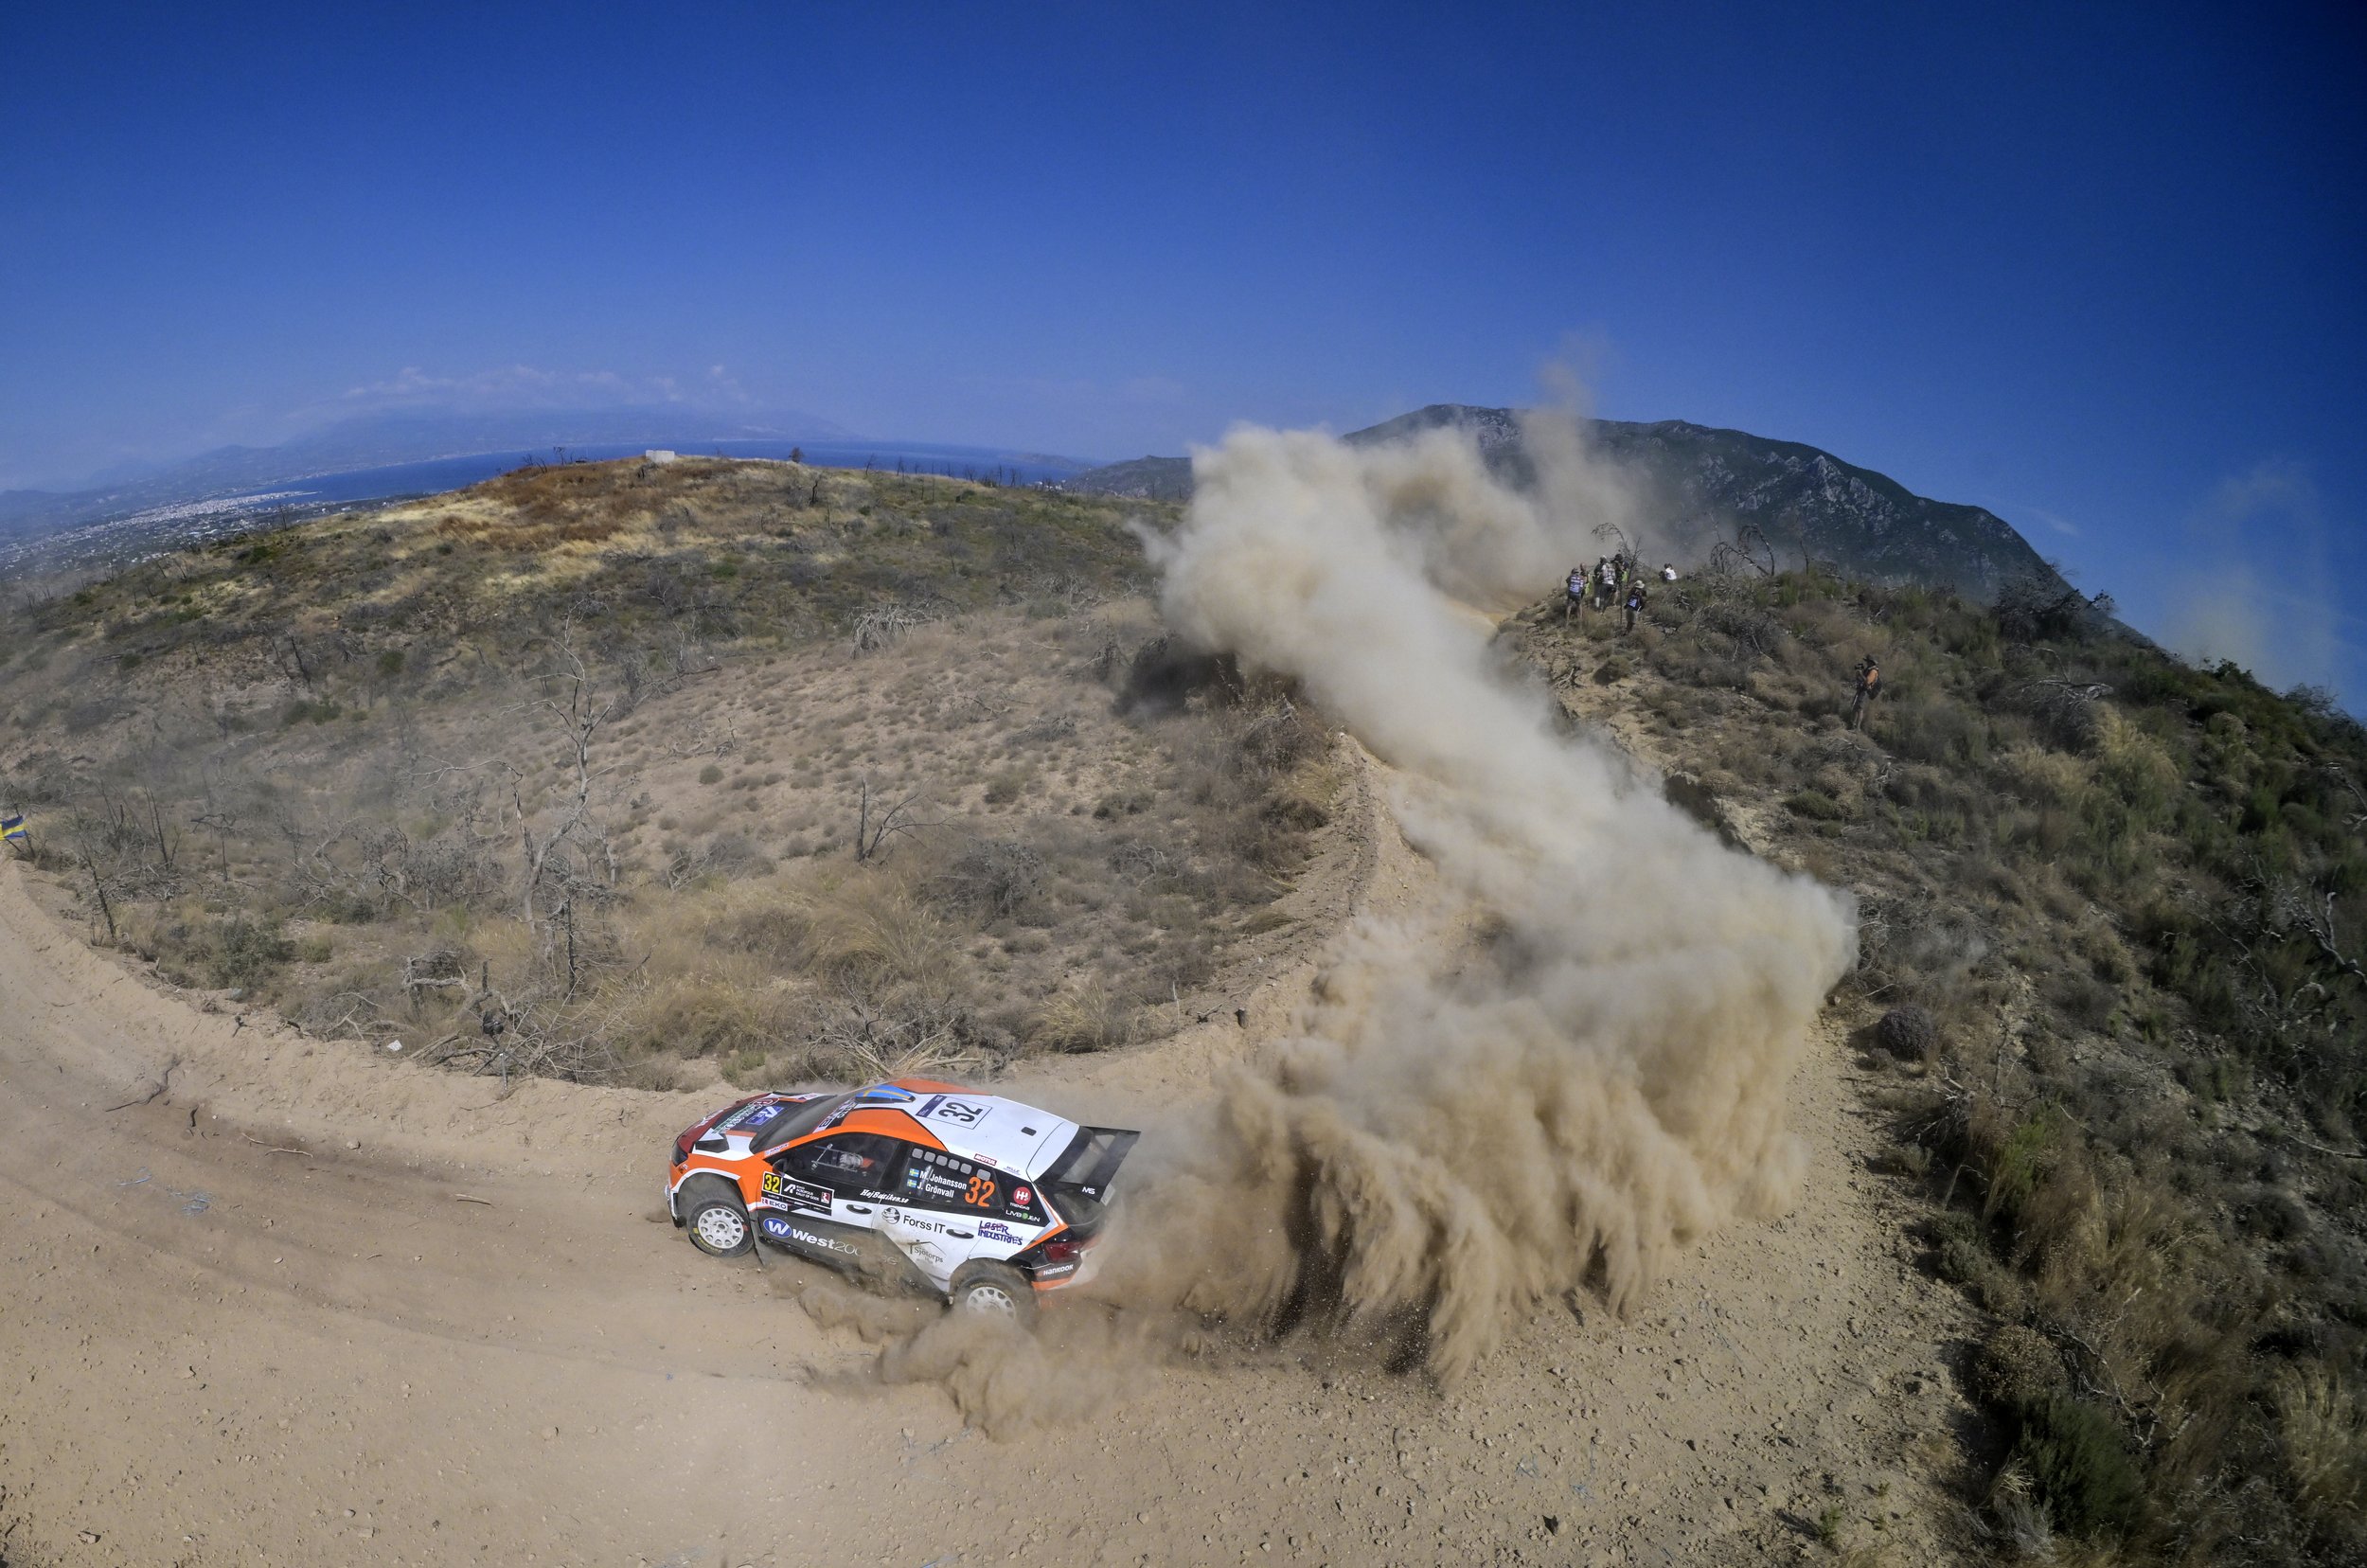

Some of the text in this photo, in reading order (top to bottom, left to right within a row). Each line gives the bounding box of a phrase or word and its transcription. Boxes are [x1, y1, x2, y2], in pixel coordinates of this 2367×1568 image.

[938, 1101, 984, 1123] 32
[974, 1154, 996, 1165] MOTUL
[764, 1174, 780, 1193] 32
[919, 1170, 968, 1190] M. Johansson
[917, 1182, 954, 1199] J. Grönvall
[964, 1176, 996, 1208] 32
[769, 1200, 787, 1210] EKO
[902, 1214, 946, 1234] Forss IT
[979, 1221, 1011, 1236] LASER
[977, 1229, 1023, 1246] INDUSTRIES
